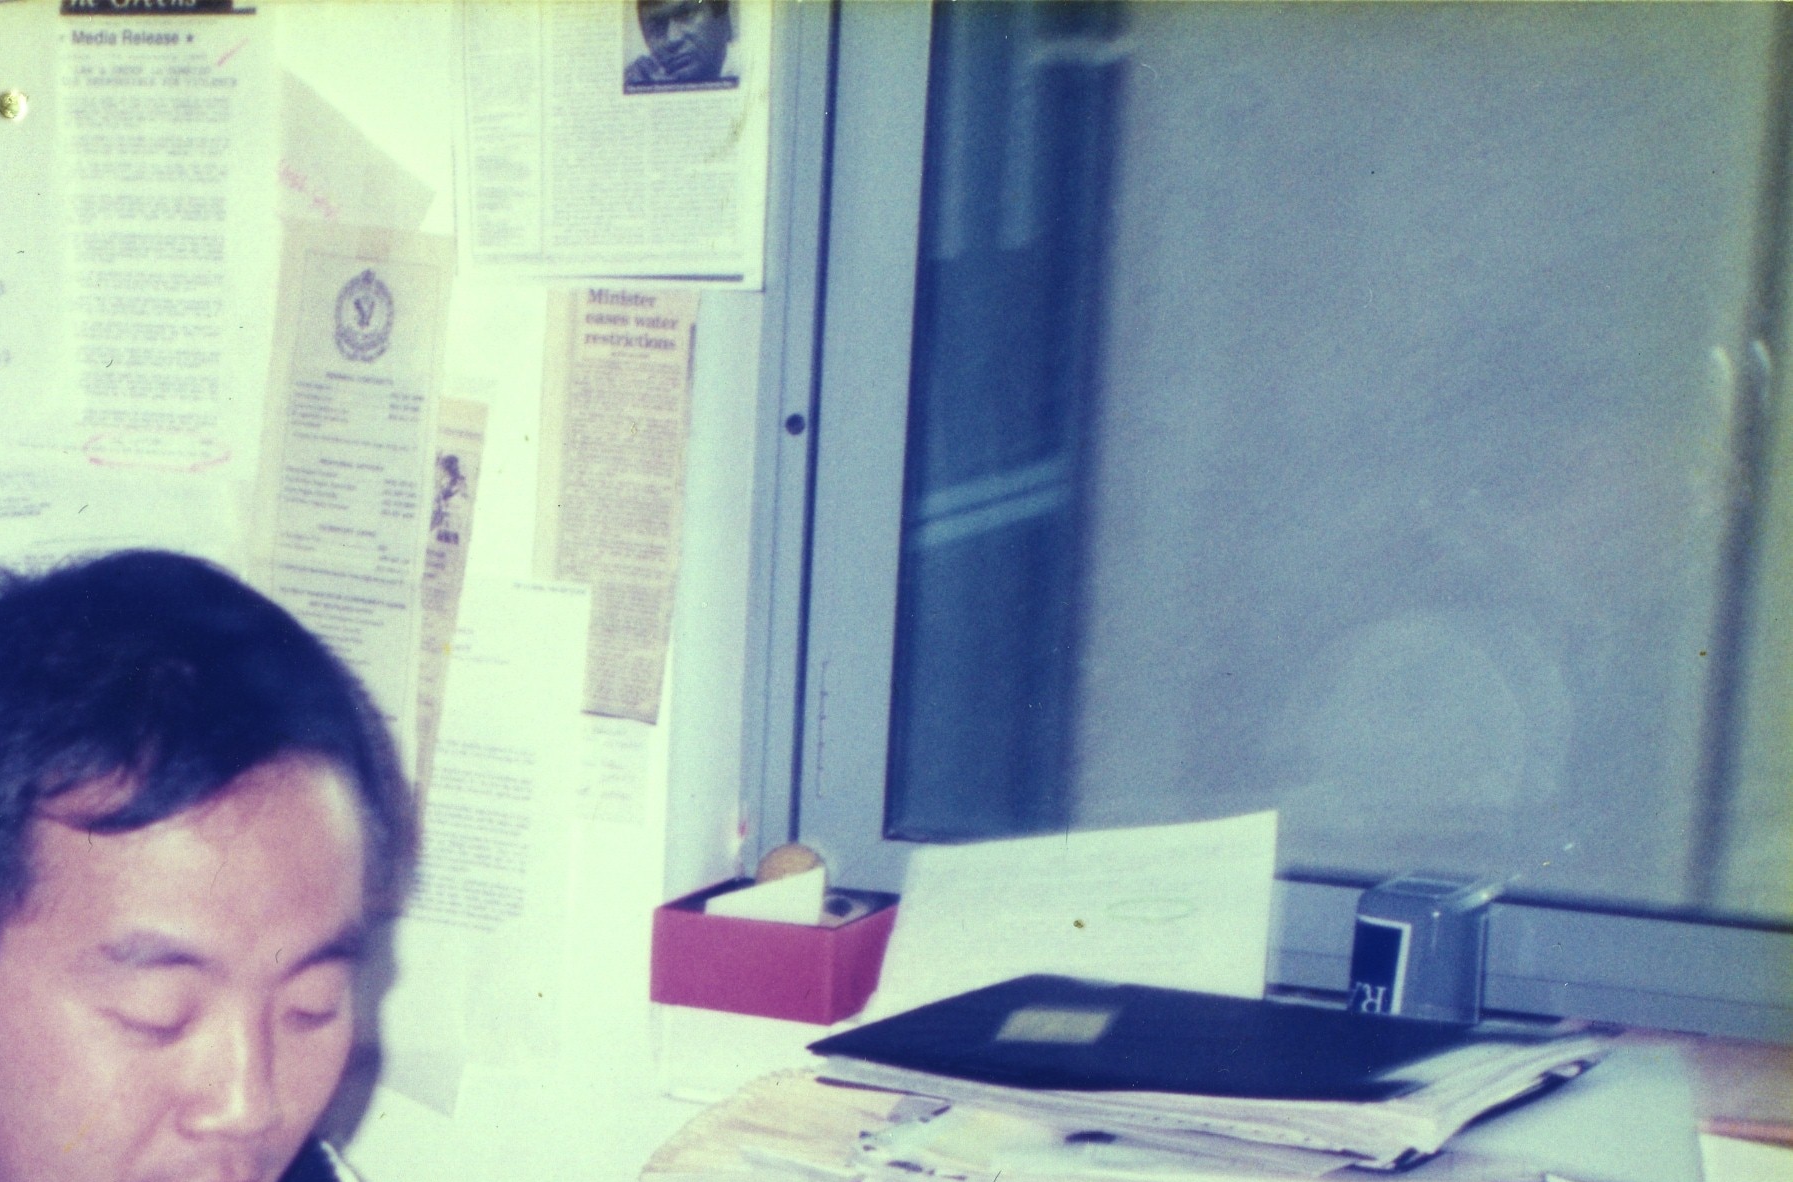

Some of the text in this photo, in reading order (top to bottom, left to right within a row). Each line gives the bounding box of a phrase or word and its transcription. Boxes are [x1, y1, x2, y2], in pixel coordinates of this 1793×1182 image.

[72, 29, 179, 45] Media Release
[587, 288, 657, 309] Minister
[585, 313, 680, 331] eases water
[584, 333, 677, 352] restrictions
